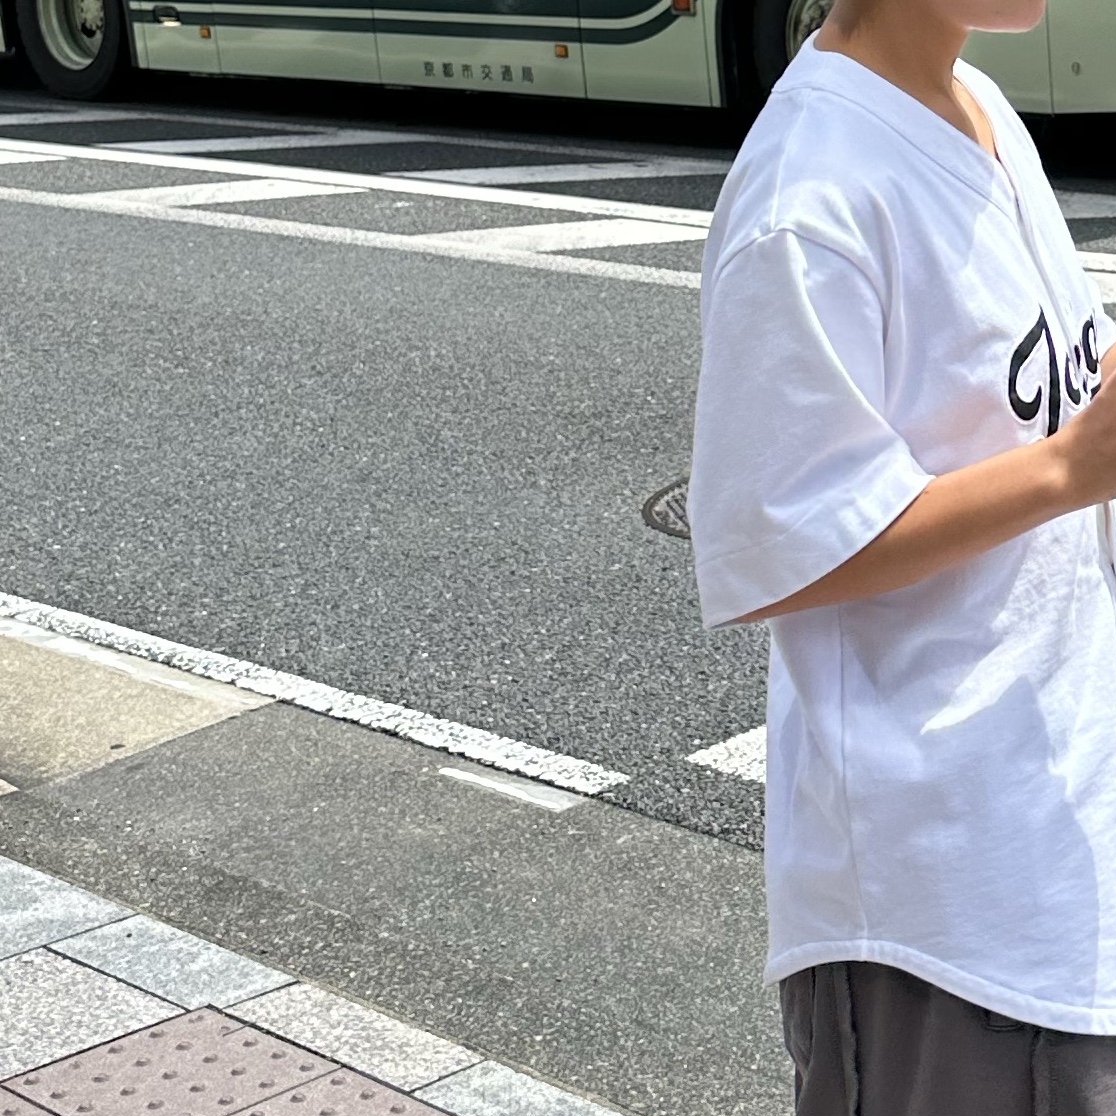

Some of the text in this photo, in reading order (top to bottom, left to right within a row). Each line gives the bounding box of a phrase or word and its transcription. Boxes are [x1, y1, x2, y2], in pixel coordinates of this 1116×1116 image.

[423, 61, 535, 84] 京都市交通局
